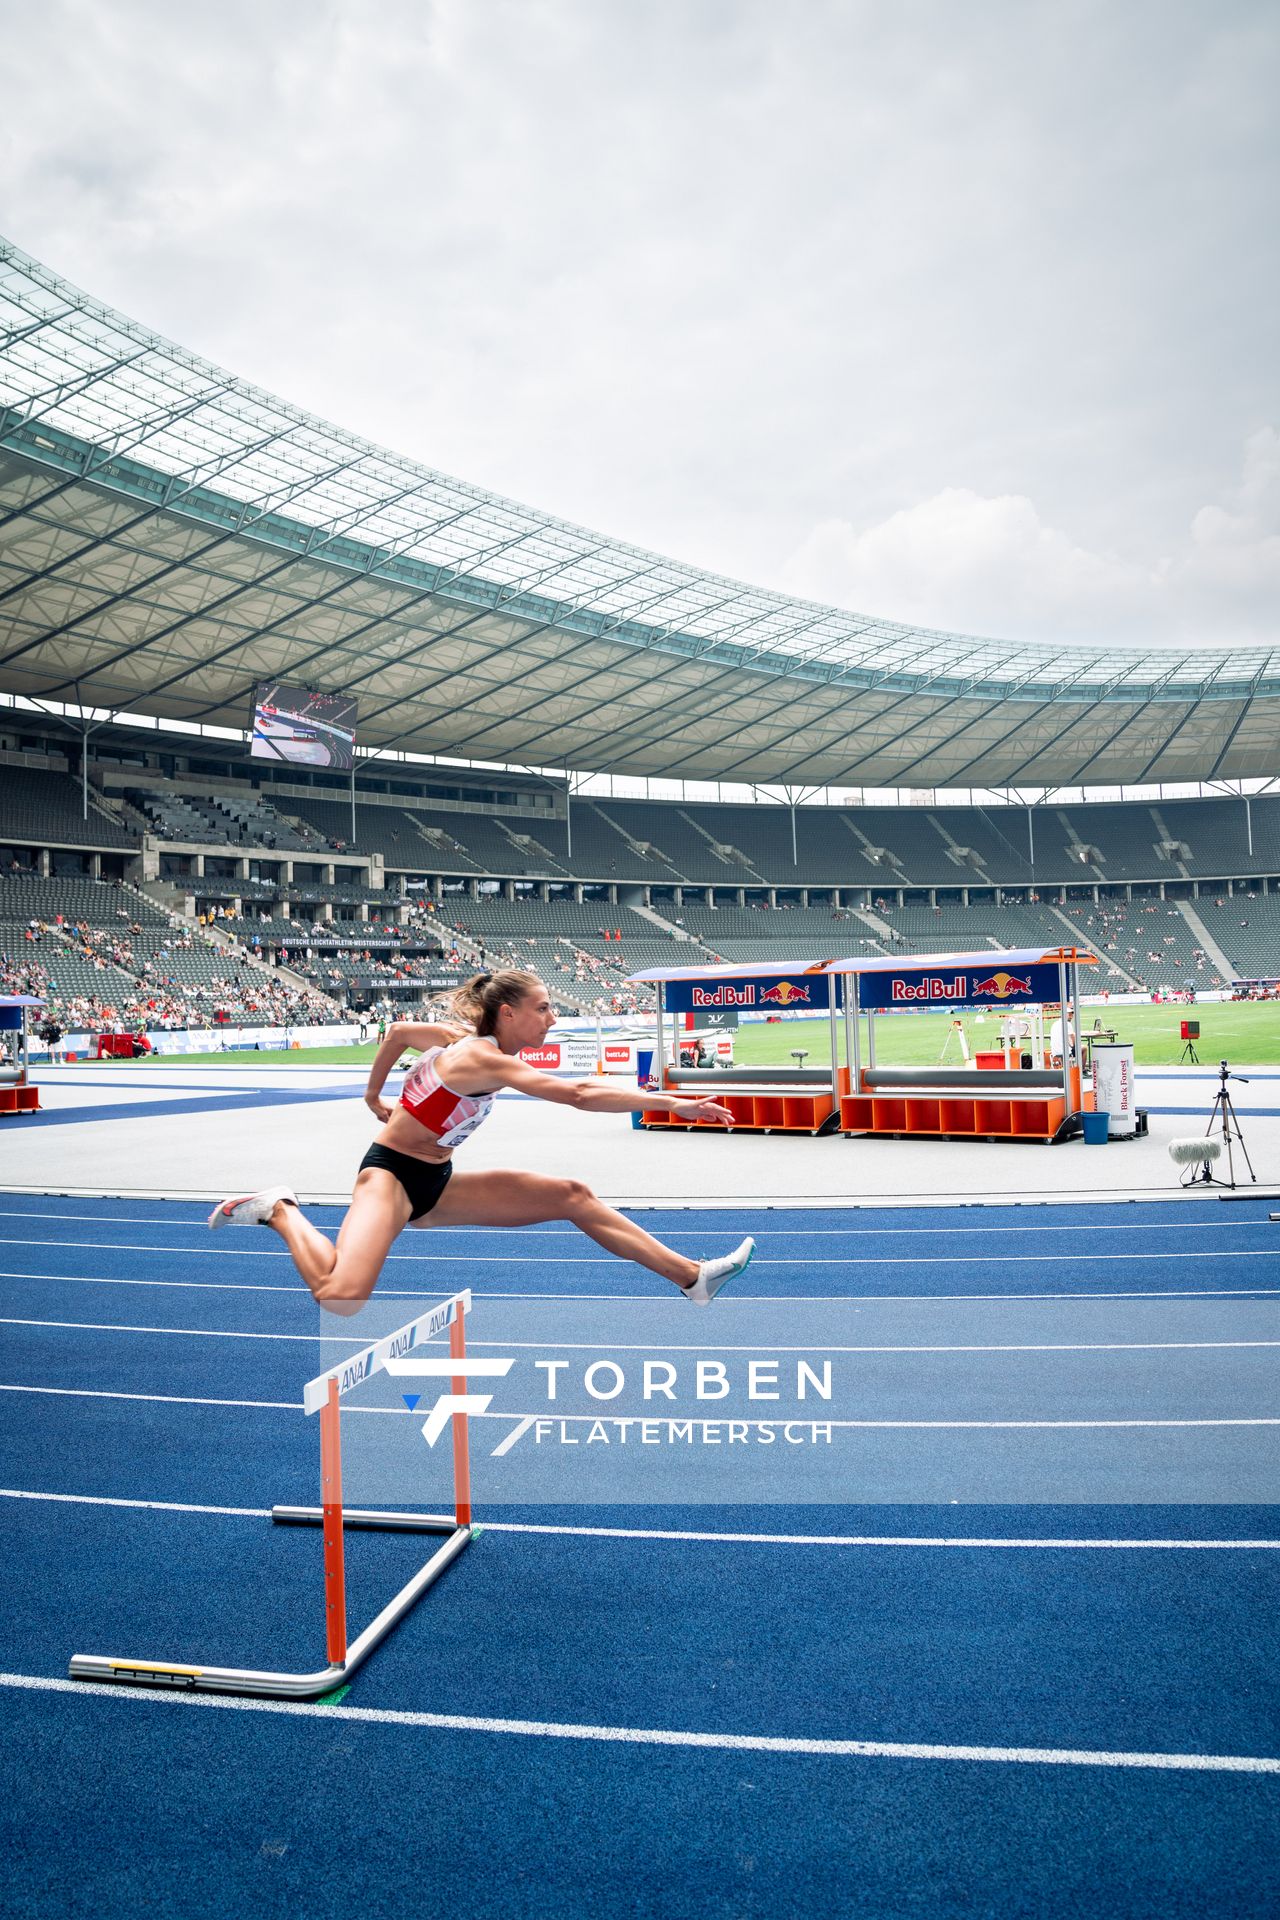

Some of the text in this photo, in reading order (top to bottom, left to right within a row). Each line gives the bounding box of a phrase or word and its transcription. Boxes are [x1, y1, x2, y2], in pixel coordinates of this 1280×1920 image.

[282, 938, 310, 946] DEUTSCHE
[692, 984, 756, 1006] Red Bull
[892, 976, 967, 1001] Red Bull
[521, 1051, 558, 1062] bett1.de
[606, 1051, 629, 1059] bett1.de
[1120, 1060, 1128, 1111] Black Forest
[428, 1310, 445, 1336] ANA
[389, 1334, 408, 1359] ANA
[341, 1361, 364, 1392] ANA
